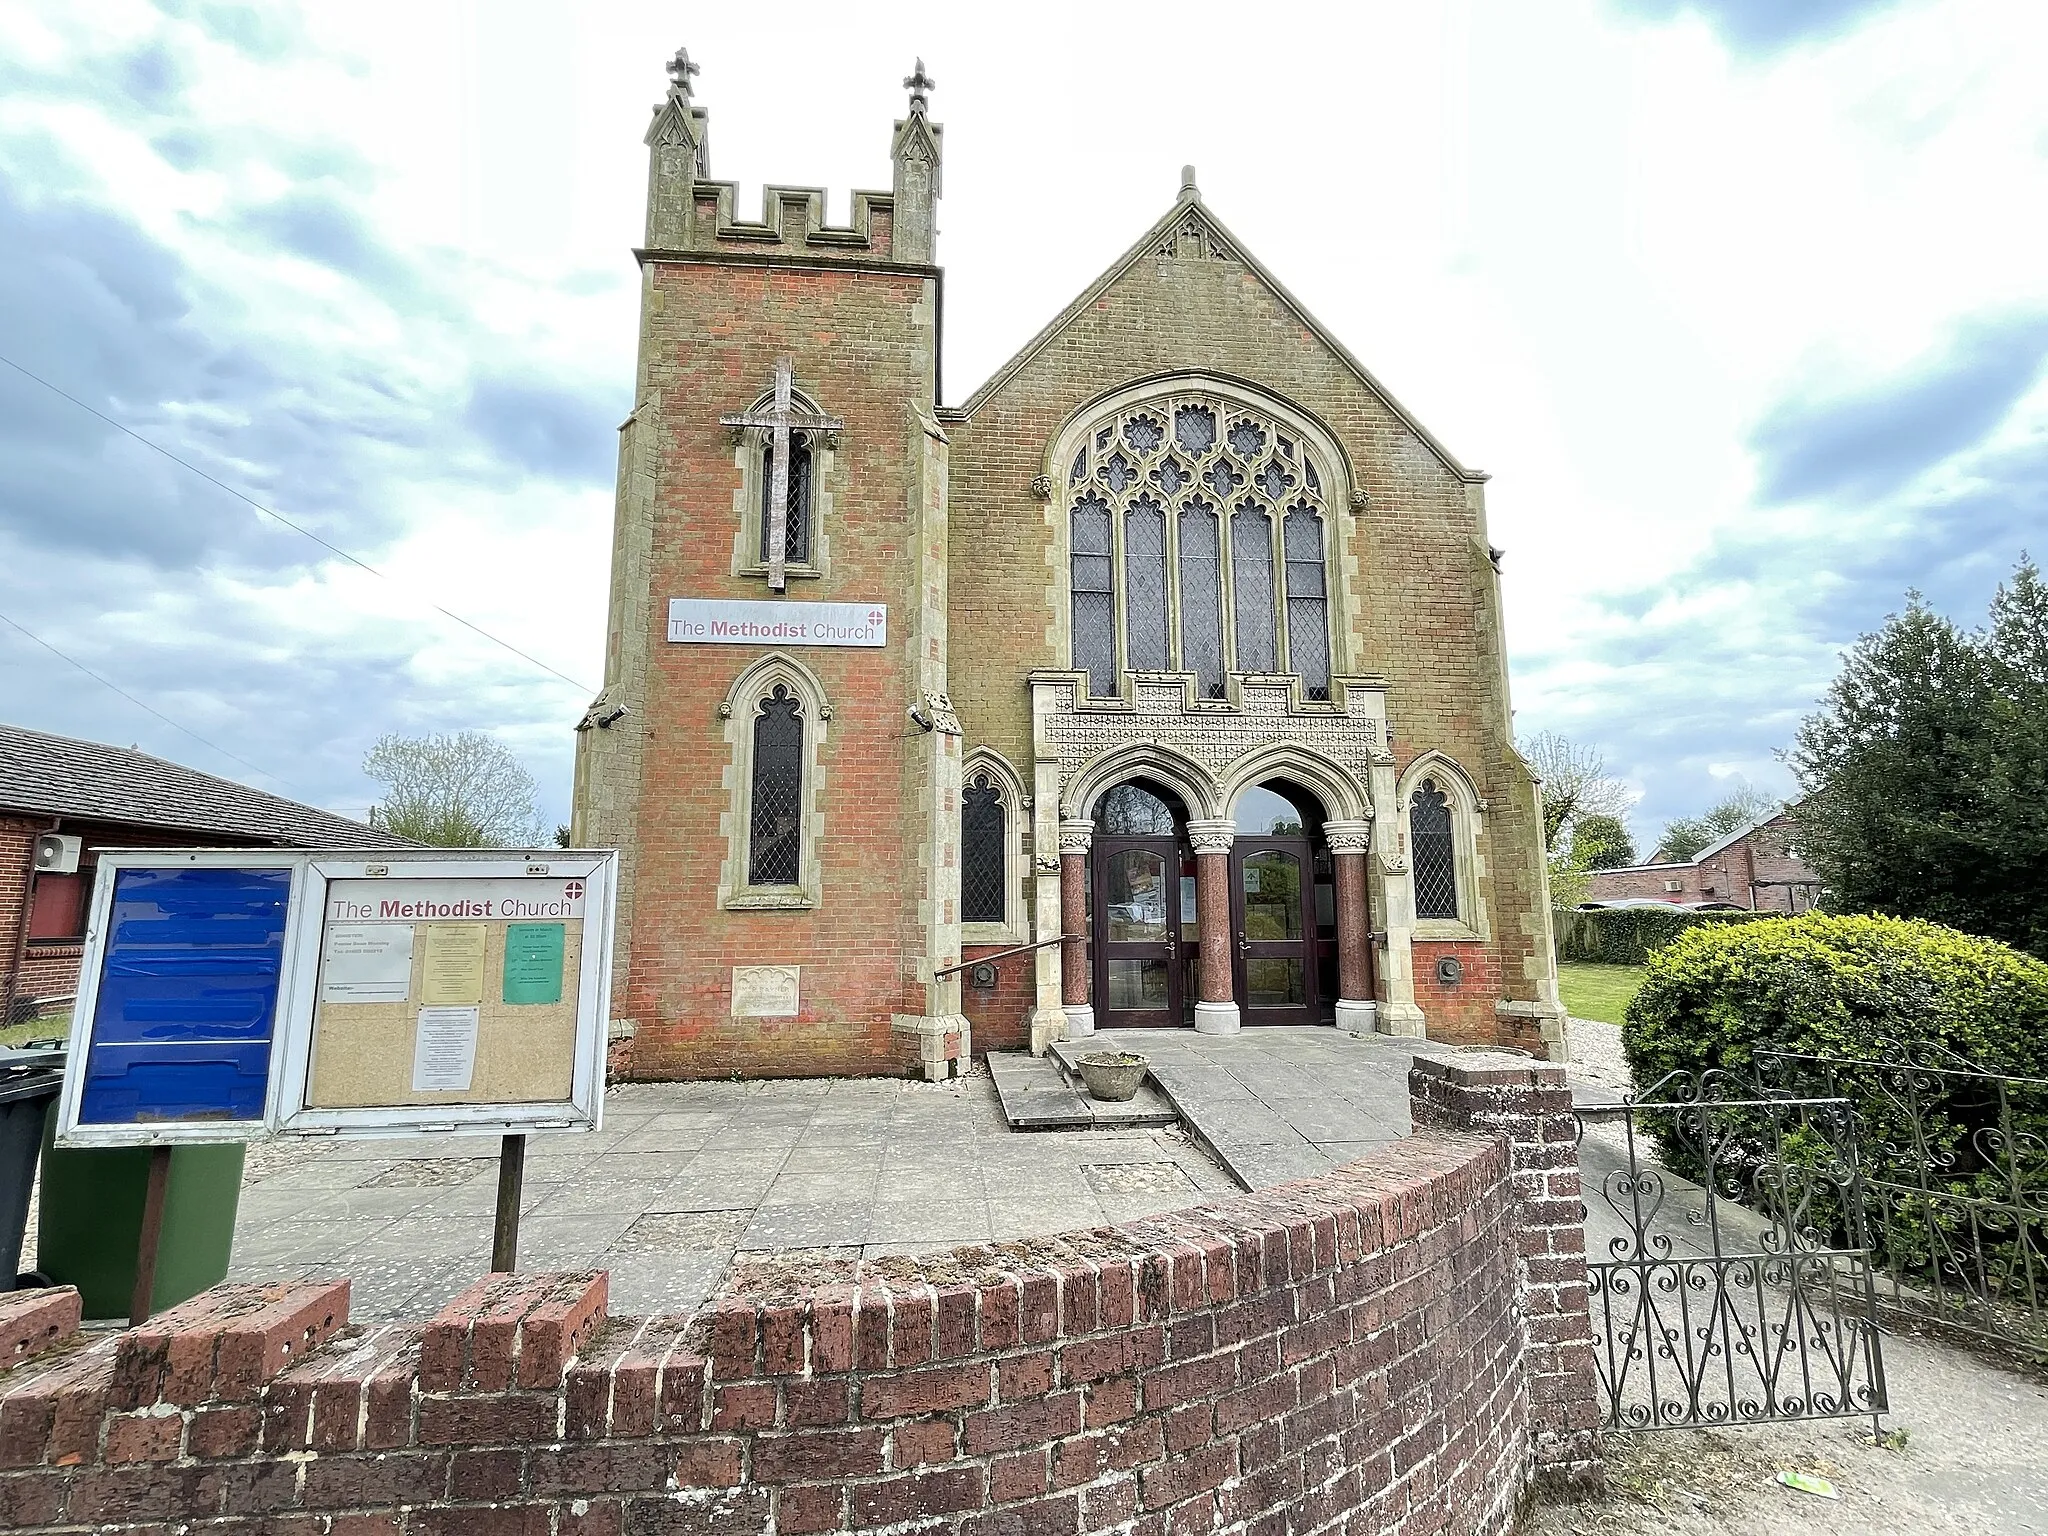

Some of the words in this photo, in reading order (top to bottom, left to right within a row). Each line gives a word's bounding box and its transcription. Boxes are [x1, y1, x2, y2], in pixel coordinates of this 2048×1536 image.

[671, 620, 705, 636] The
[711, 621, 807, 638] Methodist
[813, 623, 875, 640] Church
[333, 900, 373, 918] The
[380, 900, 493, 918] Methodist
[500, 899, 572, 917] Church
